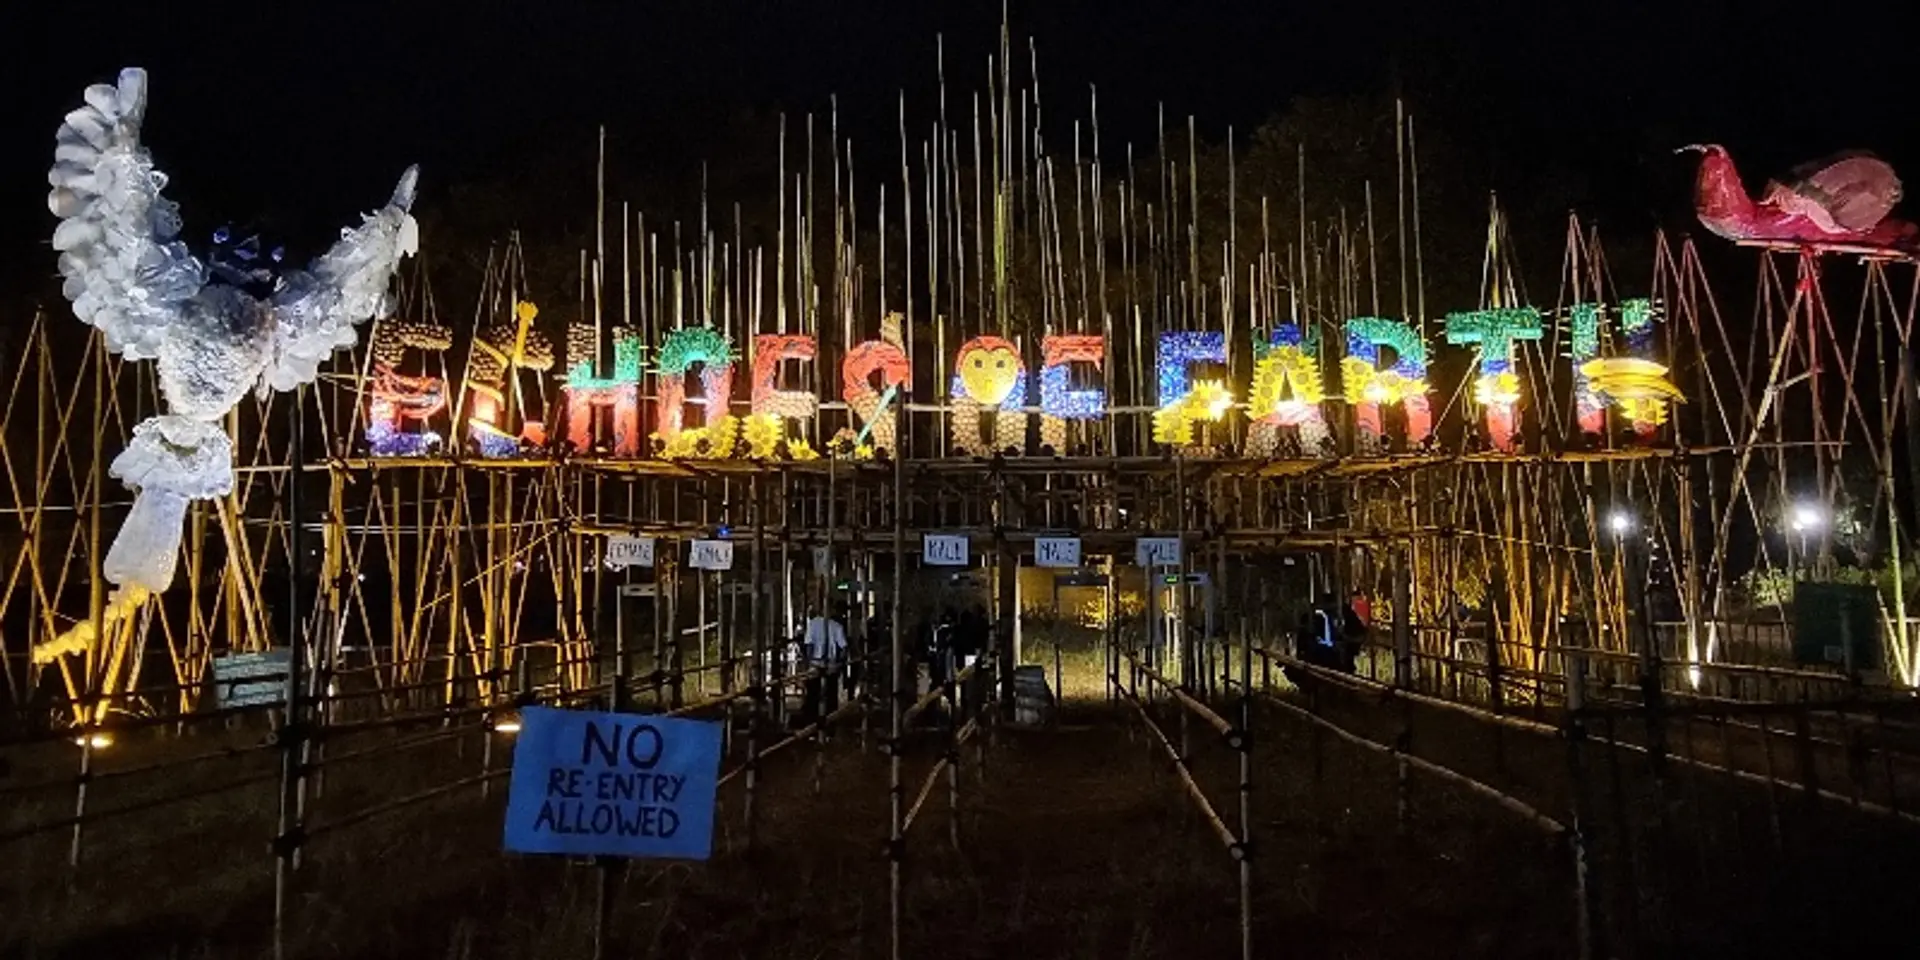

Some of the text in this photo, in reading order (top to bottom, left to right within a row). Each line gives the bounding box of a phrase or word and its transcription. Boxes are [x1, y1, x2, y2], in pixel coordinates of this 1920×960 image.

[1152, 298, 1685, 460] EARTH
[581, 720, 664, 770] NO
[547, 767, 687, 803] RE-ENTRY
[532, 799, 681, 839] ALLOWED
